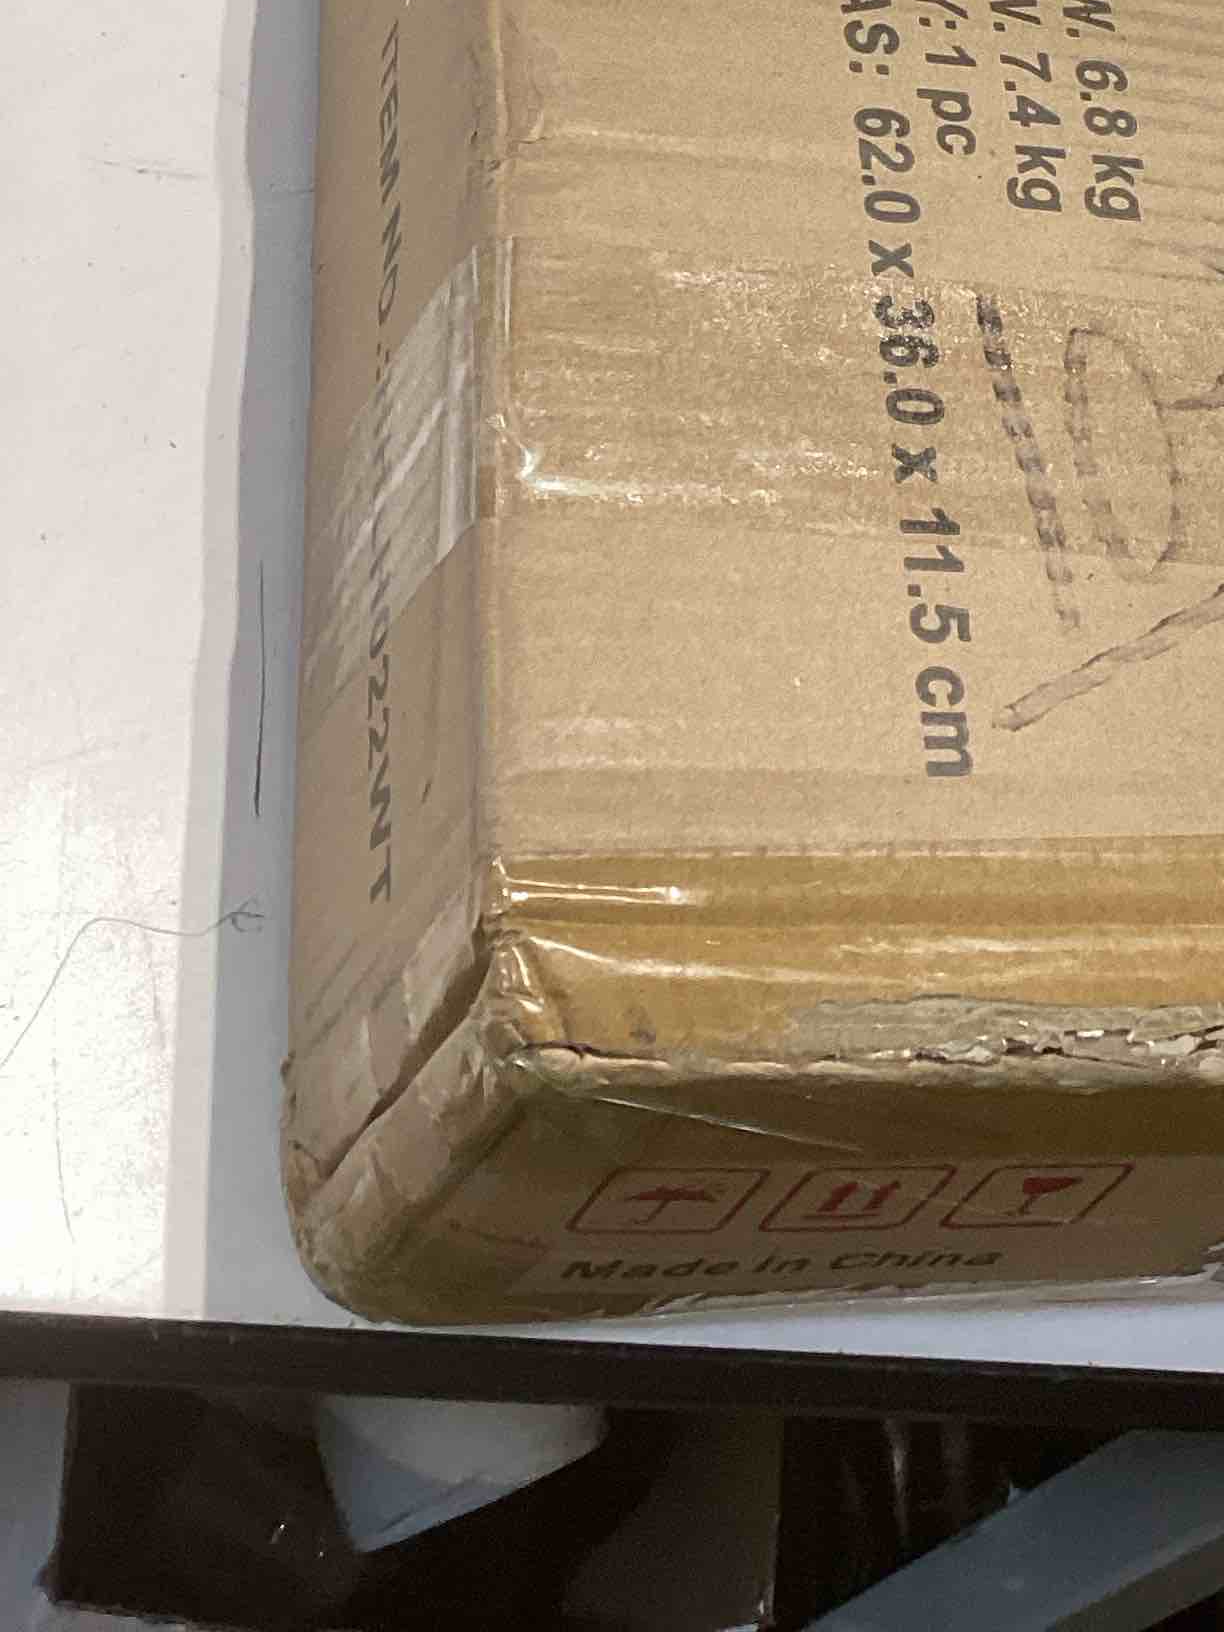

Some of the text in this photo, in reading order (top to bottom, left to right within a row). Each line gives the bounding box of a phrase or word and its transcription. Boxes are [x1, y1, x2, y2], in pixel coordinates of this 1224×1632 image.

[380, 20, 400, 205] ITEM
[917, 88, 976, 155] pc
[1000, 53, 1060, 127] 7.4
[1076, 60, 1137, 137] 6.8
[854, 108, 920, 223] 62.0
[1007, 145, 1066, 212] kg
[1084, 155, 1147, 221] kg
[869, 240, 914, 279] x
[874, 295, 945, 425] 36.0
[891, 443, 937, 484] x
[900, 508, 971, 643] 11.5
[915, 666, 973, 777] cm
[561, 1250, 1002, 1279] Made in China
